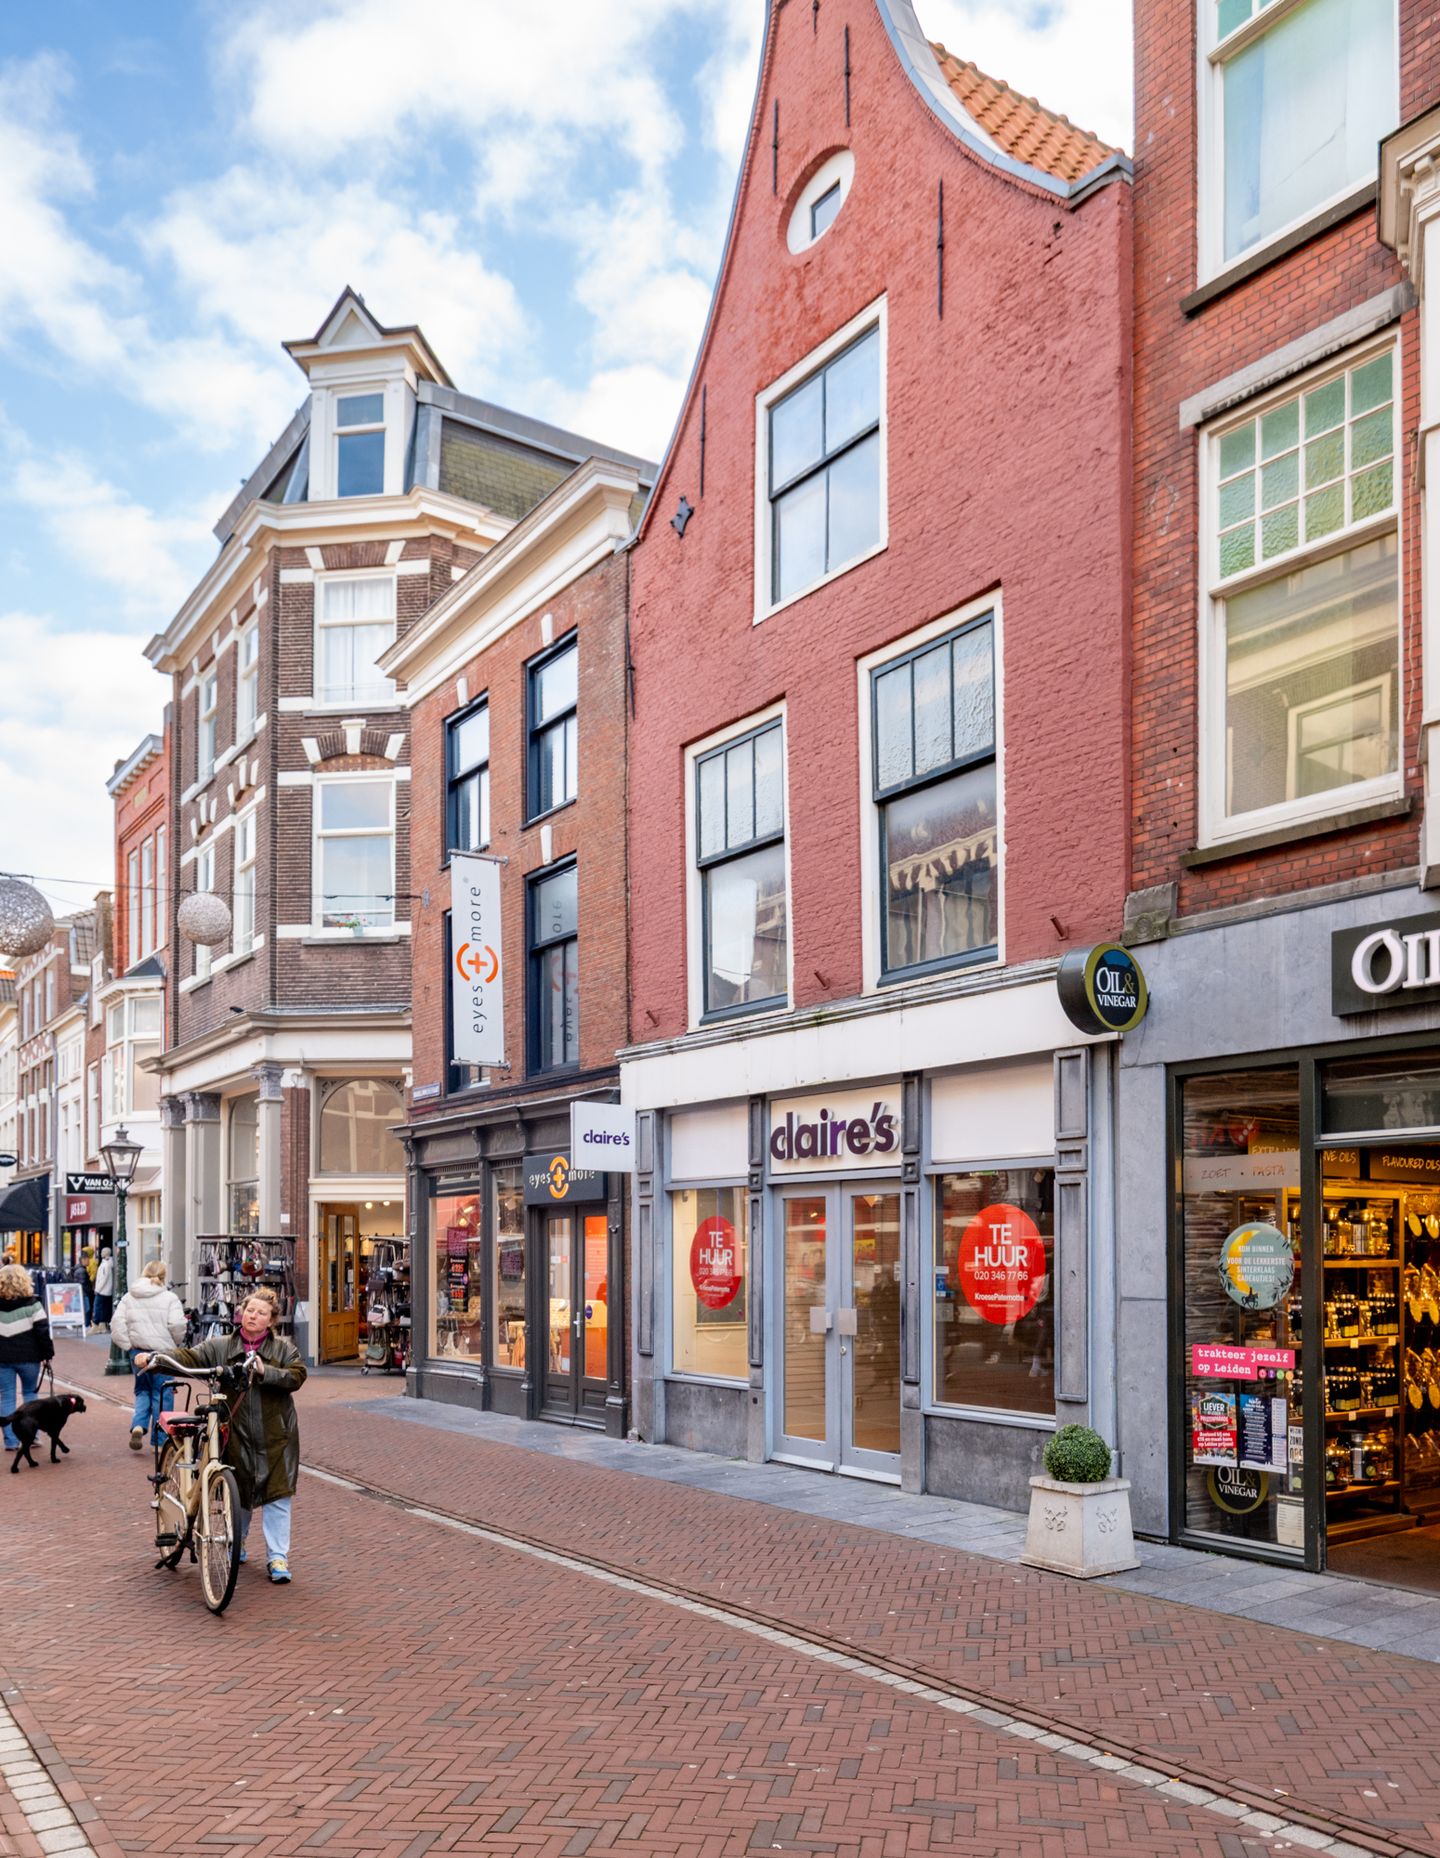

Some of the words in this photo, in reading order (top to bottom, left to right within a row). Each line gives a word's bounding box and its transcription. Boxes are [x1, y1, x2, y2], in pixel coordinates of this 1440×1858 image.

[470, 887, 481, 942] more
[1097, 994, 1136, 1008] VINEGAR
[472, 985, 487, 1033] eyes
[583, 1129, 630, 1146] claire's
[771, 1102, 896, 1160] claire's
[1382, 1155, 1424, 1169] FLAVOURED
[84, 1178, 100, 1186] VAN
[529, 1172, 551, 1189] eyes
[708, 1231, 724, 1248] TE
[989, 1223, 1012, 1245] TE
[699, 1248, 733, 1265] HUUR
[974, 1246, 1028, 1267] HUUR
[1239, 1245, 1250, 1253] KOM
[1244, 1257, 1252, 1265] DE
[1253, 1257, 1286, 1265] LEKKERSTE
[974, 1271, 989, 1280] 020
[991, 1271, 1006, 1280] 346
[1237, 1266, 1275, 1274] SINTERKLAAS
[1198, 1348, 1246, 1360] trakteer
[1250, 1351, 1289, 1363] jezelf
[1198, 1363, 1211, 1373] op
[1214, 1363, 1251, 1375] Leiden
[1203, 1402, 1225, 1412] LIEVER
[1218, 1483, 1257, 1498] VINEGAR
